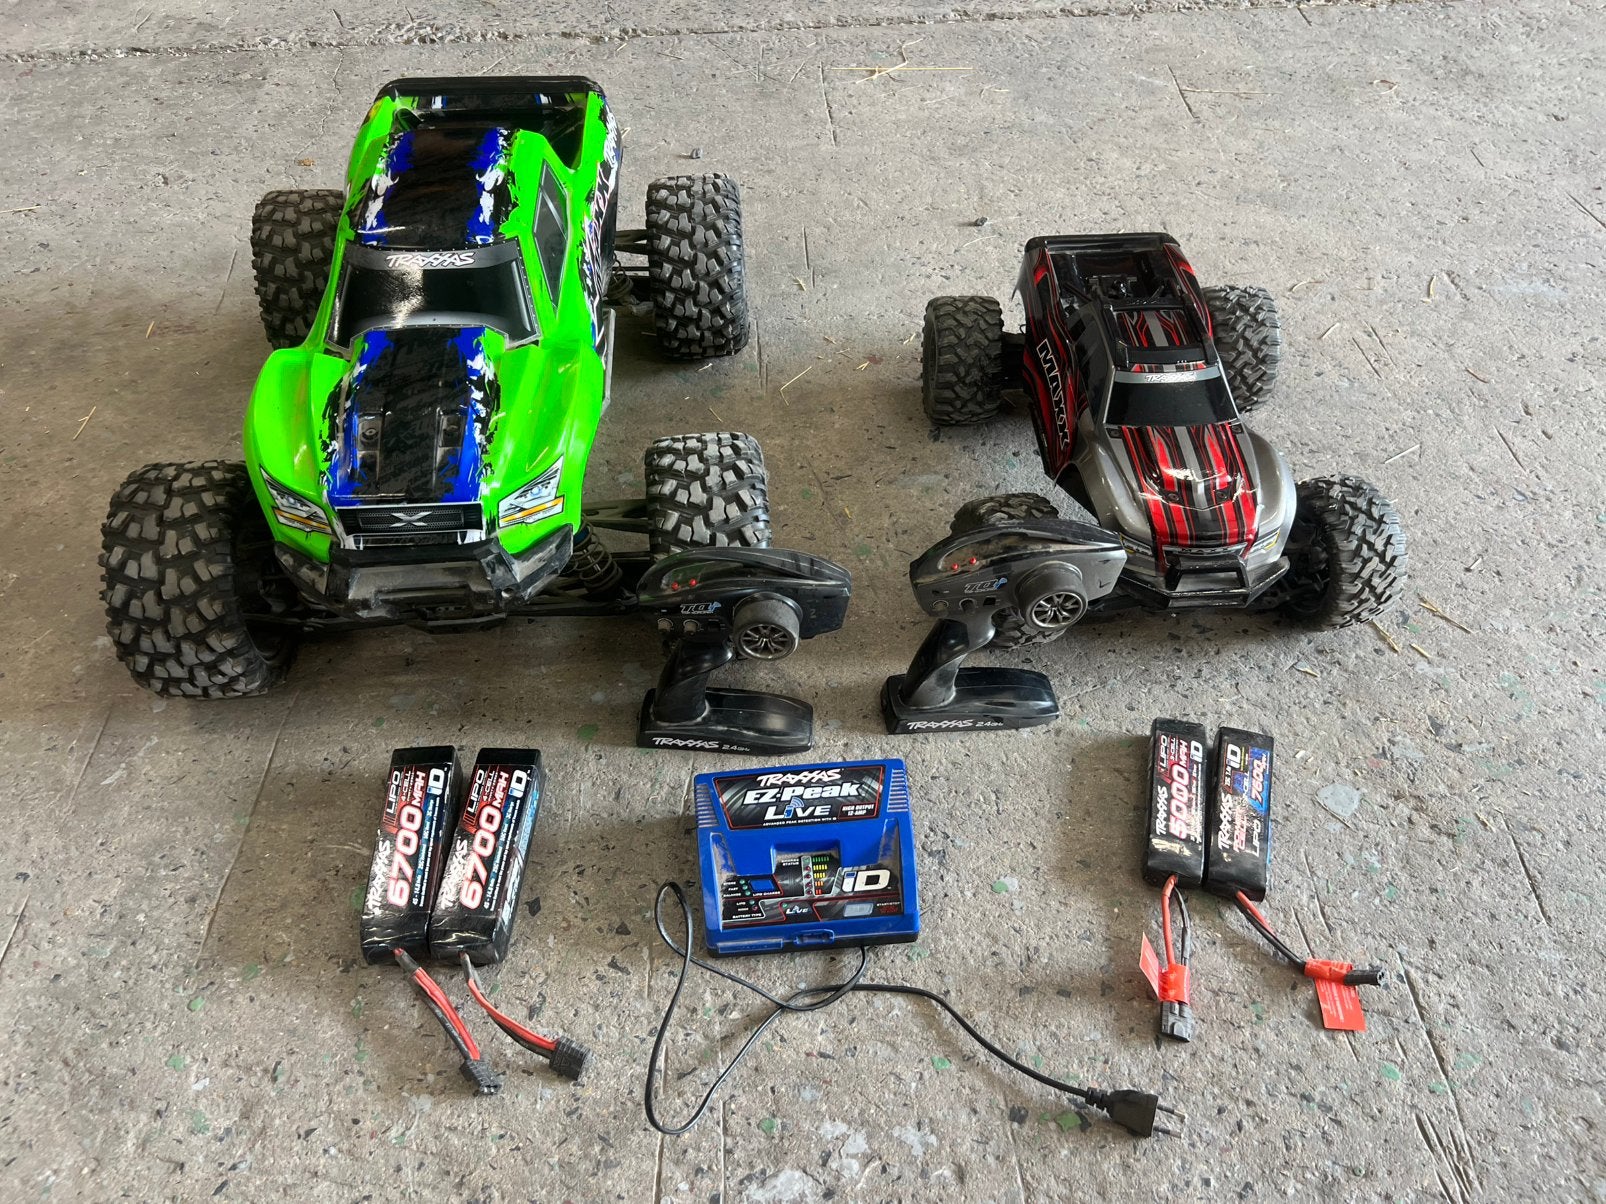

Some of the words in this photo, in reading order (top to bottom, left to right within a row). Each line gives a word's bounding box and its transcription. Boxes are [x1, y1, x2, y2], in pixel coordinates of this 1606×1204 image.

[386, 252, 475, 268] TRAXXAS
[1036, 338, 1070, 450] MAXX
[652, 737, 719, 748] TRAXXAS
[907, 719, 973, 730] TRAXXAS
[386, 770, 401, 814] LIPO
[467, 769, 485, 814] LIPO
[757, 769, 841, 786] TRAXXAS
[1251, 759, 1265, 804] 7600
[1156, 785, 1168, 835] TRAXXAS
[1169, 764, 1190, 839] 5000
[1218, 793, 1234, 849] TRAXXAS
[366, 839, 391, 916] TRAXXAS
[386, 804, 423, 907] 6700
[459, 805, 502, 909] 6700
